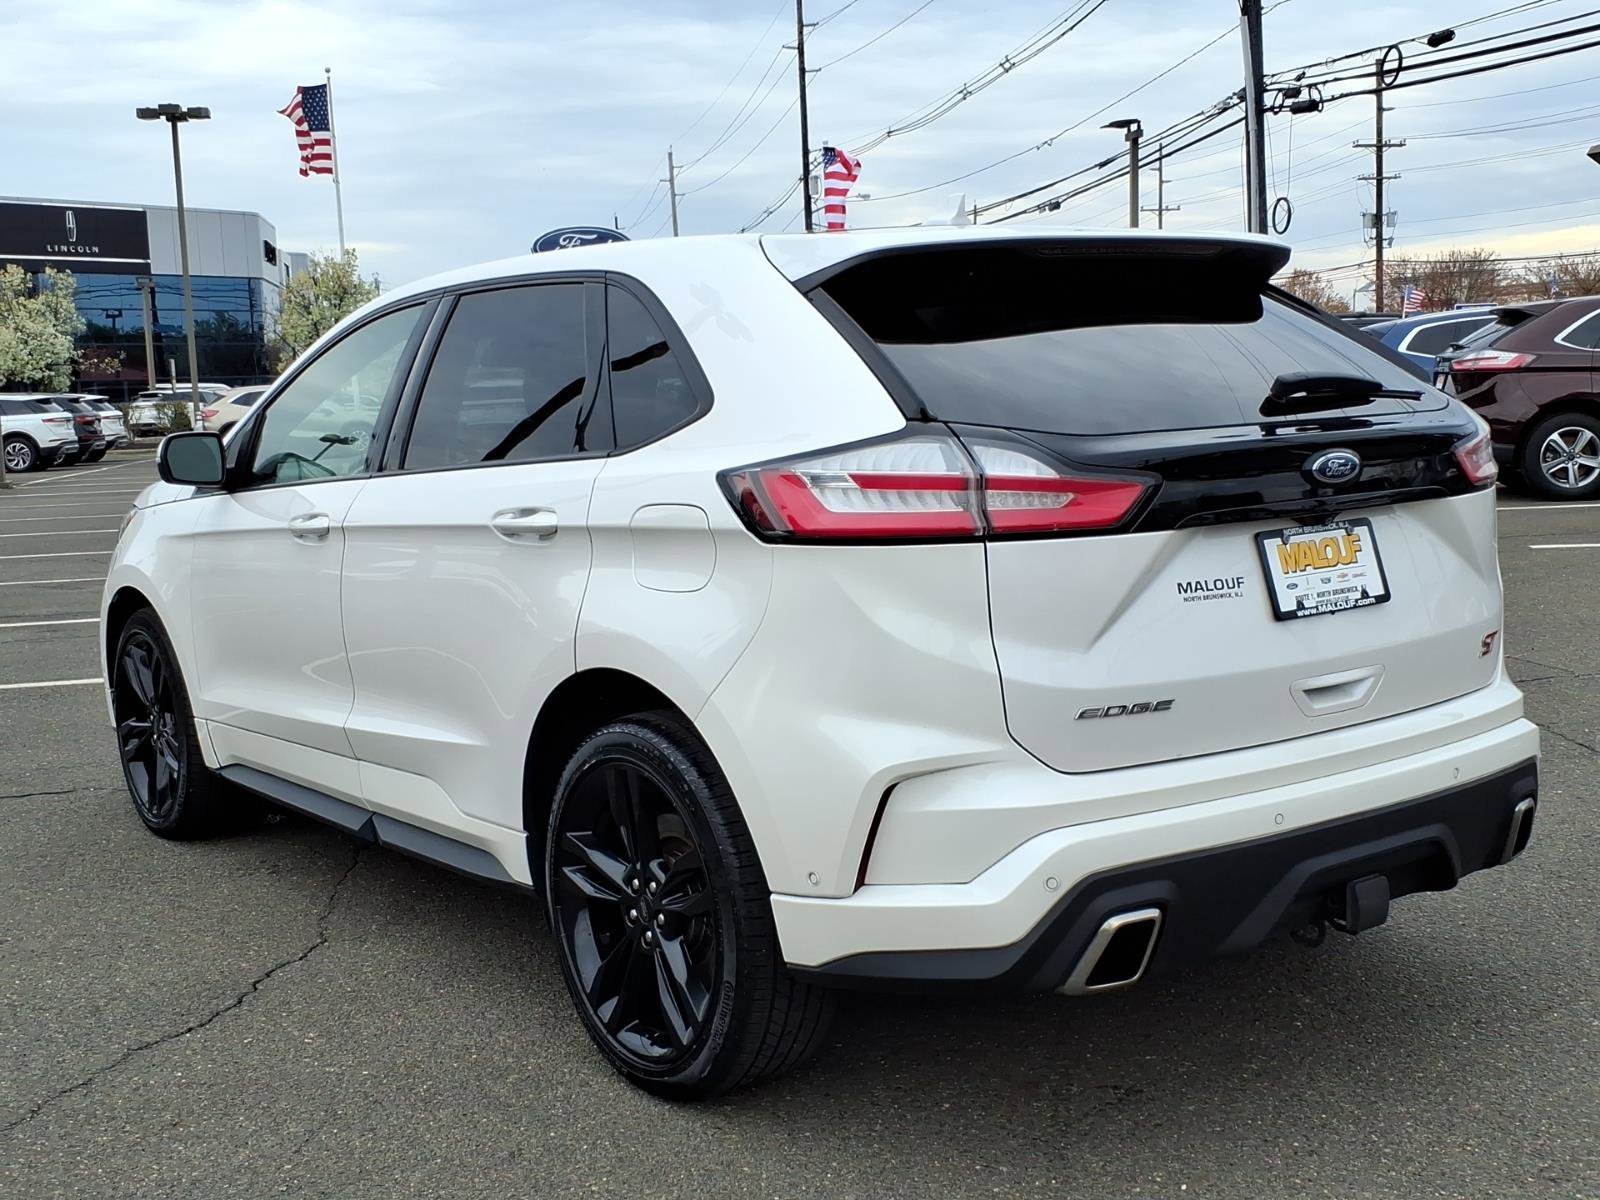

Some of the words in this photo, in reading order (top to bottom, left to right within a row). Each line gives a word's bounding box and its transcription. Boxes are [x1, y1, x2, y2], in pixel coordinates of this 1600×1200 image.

[47, 244, 99, 253] LINCOLN
[1277, 533, 1362, 575] MALOUF
[1177, 576, 1244, 594] MALOUF
[1183, 595, 1202, 603] NORTH
[1296, 597, 1376, 617] www.MALOUF.com
[1479, 630, 1498, 659] ST
[1074, 699, 1176, 720] EDGE
